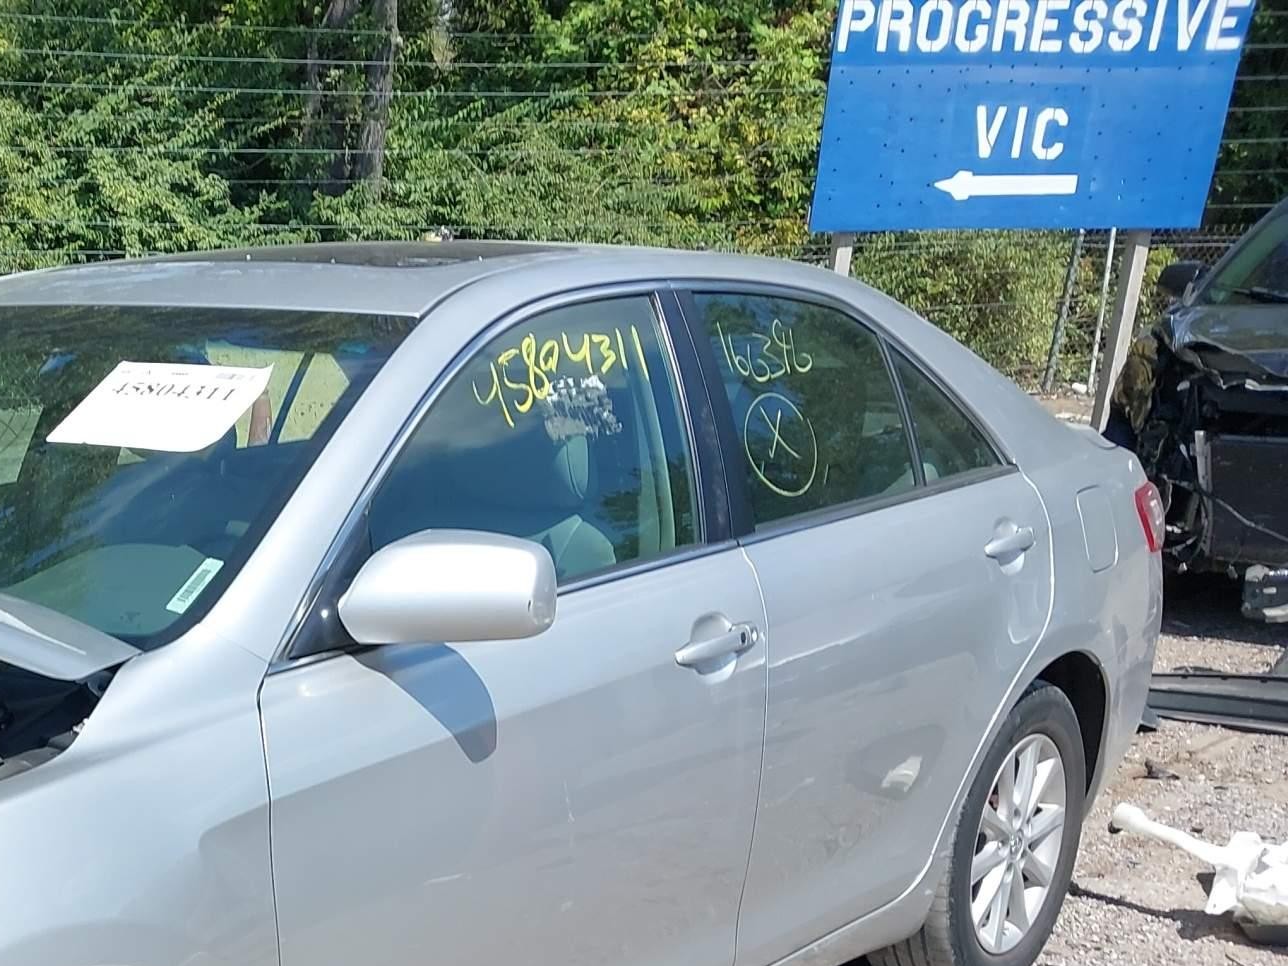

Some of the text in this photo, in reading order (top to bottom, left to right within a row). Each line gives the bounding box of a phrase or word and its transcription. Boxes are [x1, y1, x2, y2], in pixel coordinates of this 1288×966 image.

[836, 0, 1252, 53] PROGRESSIVE
[976, 104, 1069, 160] VIC
[472, 324, 650, 428] 45804311
